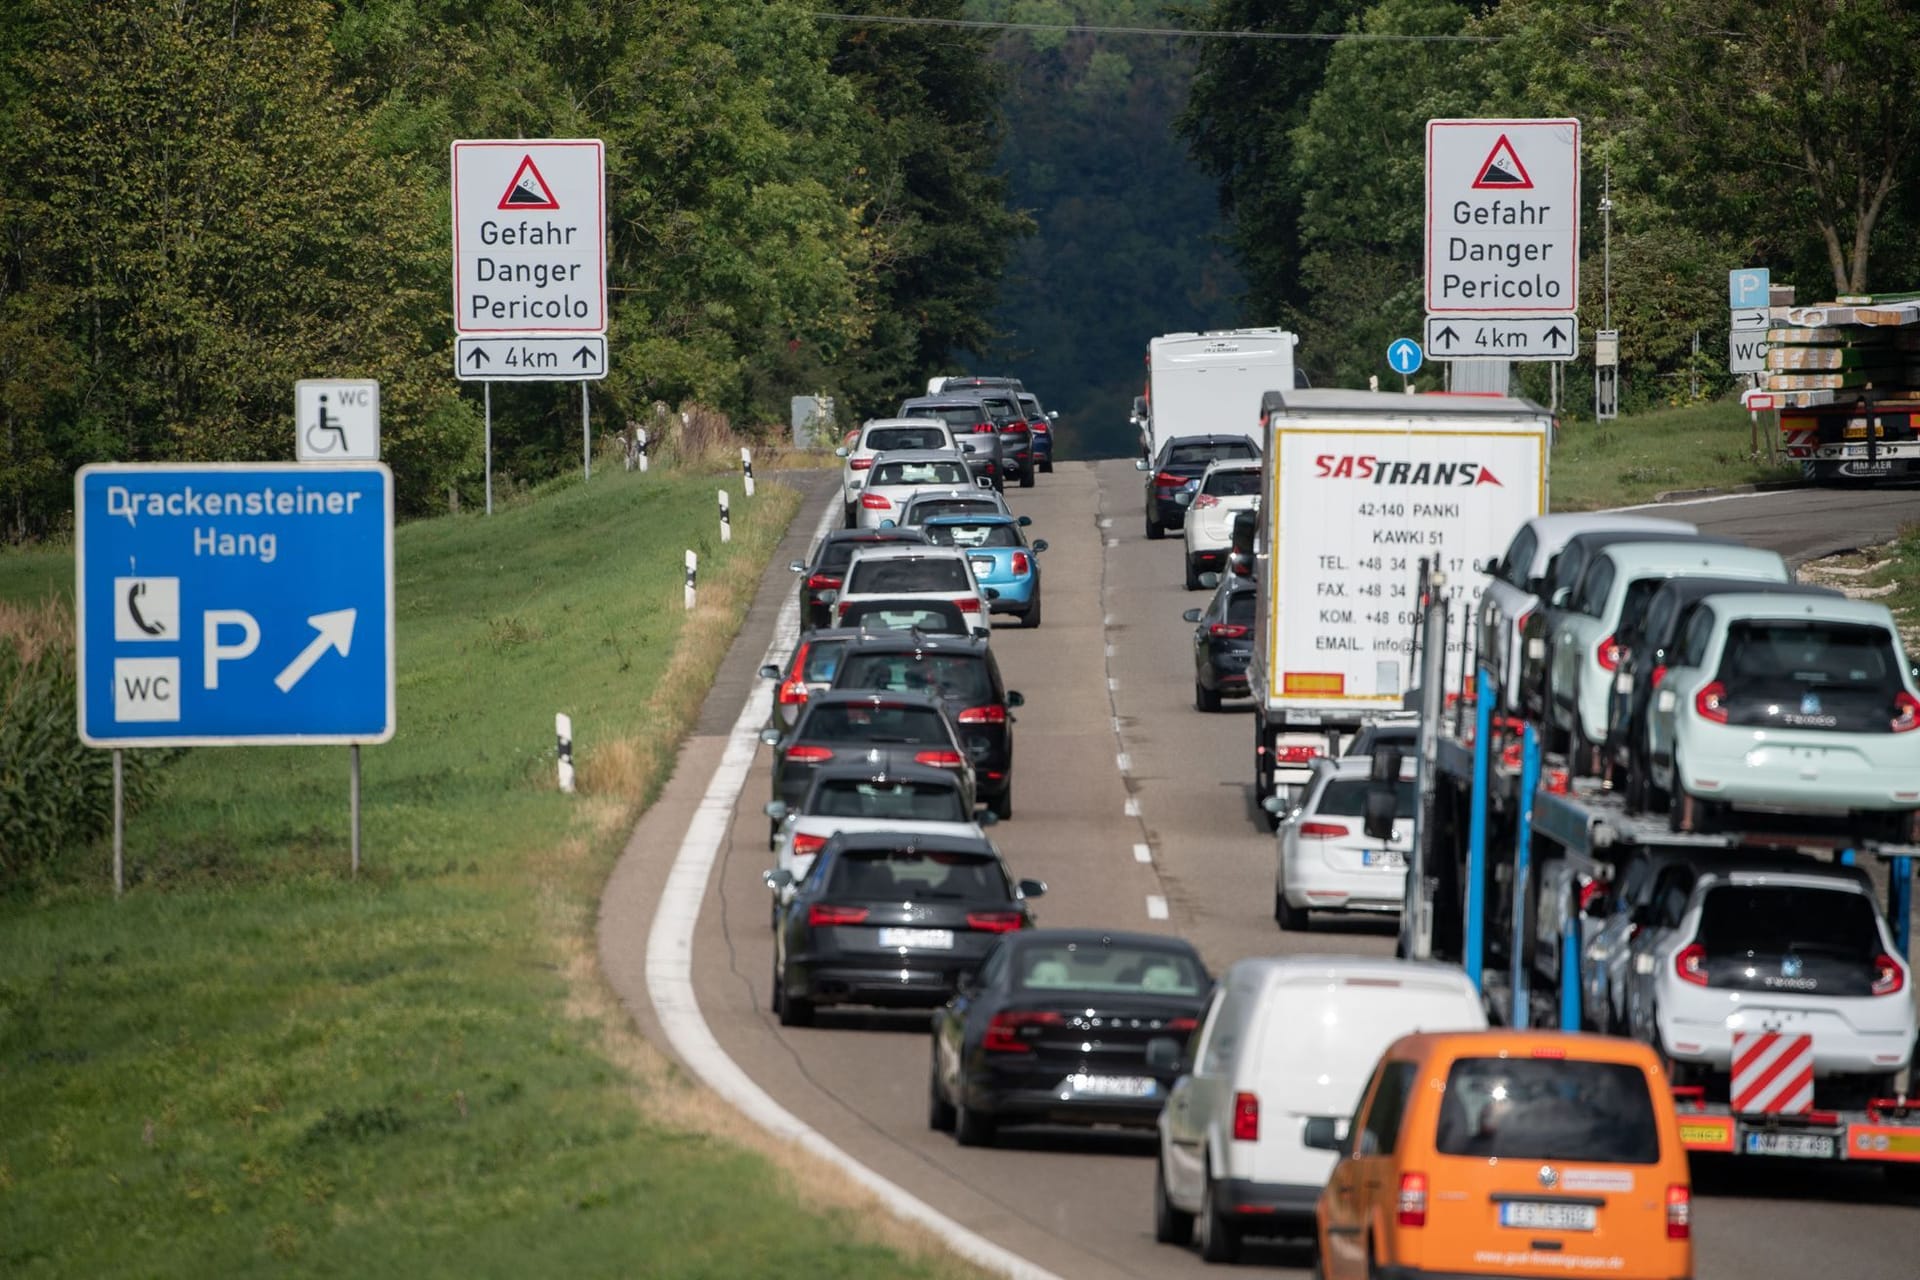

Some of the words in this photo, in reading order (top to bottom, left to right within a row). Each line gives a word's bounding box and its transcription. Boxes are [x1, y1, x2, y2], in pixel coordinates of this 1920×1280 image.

[1454, 200, 1550, 225] Gefahr
[481, 221, 577, 245] Gefahr
[1450, 237, 1553, 267] Danger
[477, 258, 581, 288] Danger
[1444, 274, 1560, 298] Pericolo
[1738, 274, 1760, 304] P
[472, 295, 588, 319] Pericolo
[1736, 342, 1768, 360] WC
[339, 390, 369, 407] WC
[1314, 454, 1479, 487] SASTRANS
[107, 486, 361, 516] Drackensteiner
[1358, 503, 1405, 517] 42-140
[1413, 504, 1459, 518] PANKI
[194, 527, 277, 563] Hang
[1373, 530, 1424, 545] KAWKI
[1429, 531, 1443, 545] 51
[1318, 556, 1349, 570] TEL.
[1358, 557, 1382, 571] +48
[1390, 557, 1406, 571] 34
[1450, 558, 1464, 572] 17
[1317, 583, 1349, 597] FAX.
[1358, 584, 1382, 598] +48
[1390, 584, 1406, 598] 34
[1450, 585, 1464, 599] 17
[1319, 610, 1356, 624] KOM.
[1366, 611, 1390, 625] +48
[204, 609, 261, 689] P
[1316, 636, 1364, 650] EMAIL.
[124, 677, 170, 701] WC
